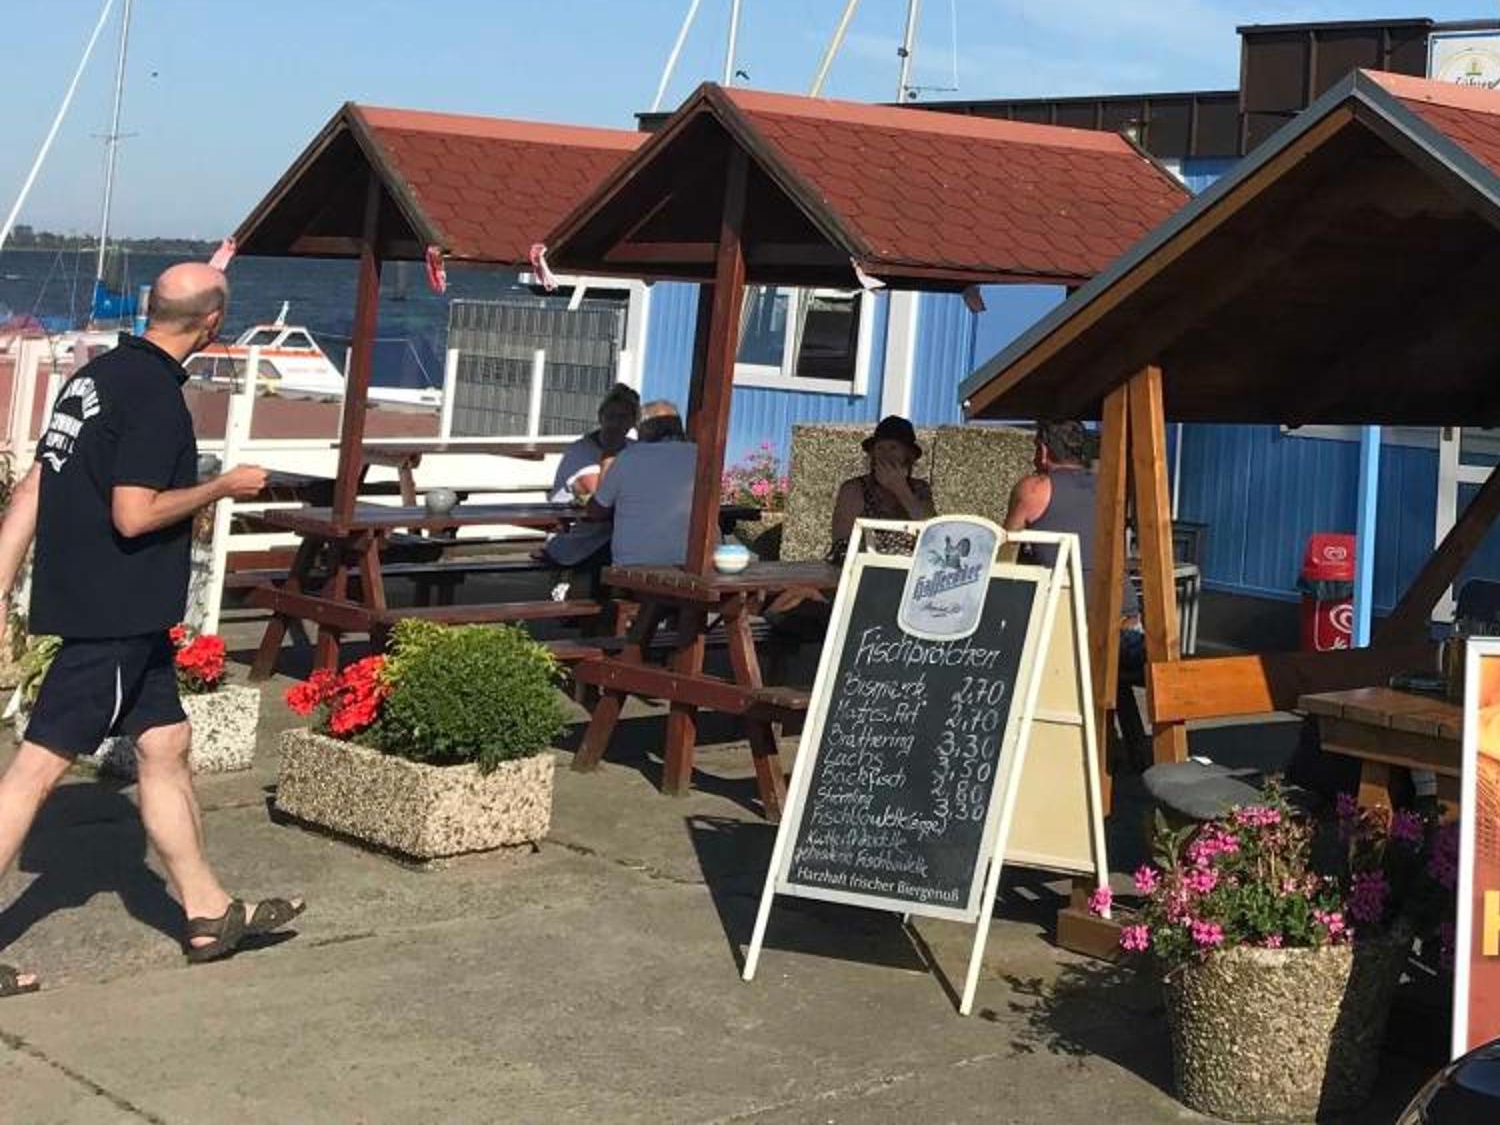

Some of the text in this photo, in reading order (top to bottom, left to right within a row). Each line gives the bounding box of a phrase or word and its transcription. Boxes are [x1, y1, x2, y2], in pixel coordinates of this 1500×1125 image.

[951, 676, 1006, 706] 2,70
[934, 730, 996, 760] 3,30
[849, 873, 895, 893] frischer
[897, 880, 960, 903] Biergenuß
